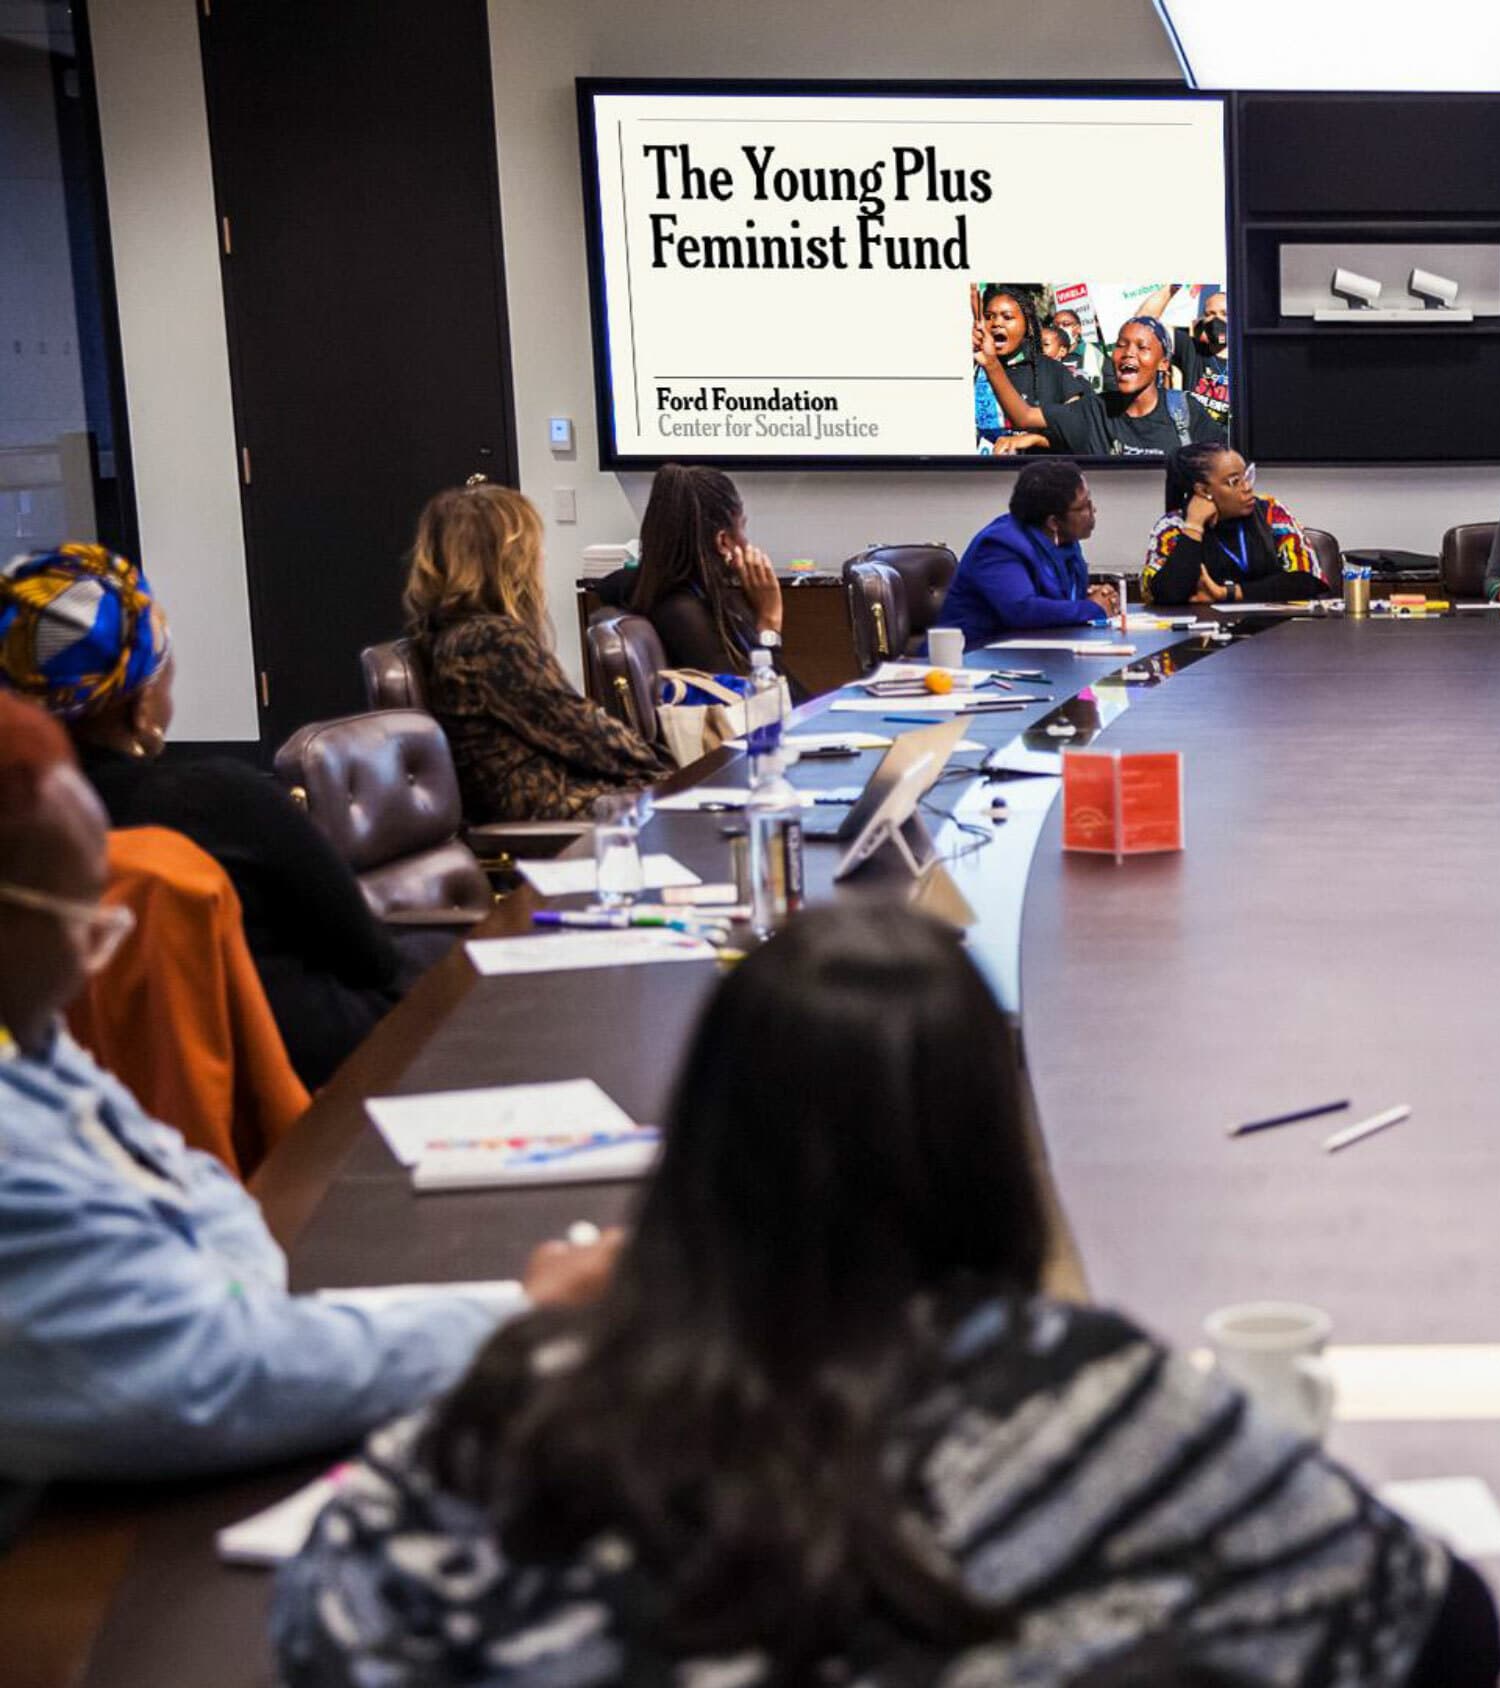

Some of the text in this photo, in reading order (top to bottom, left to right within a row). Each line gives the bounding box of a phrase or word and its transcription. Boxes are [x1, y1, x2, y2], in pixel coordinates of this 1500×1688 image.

[643, 144, 992, 214] The Young Plus
[650, 214, 970, 270] Feminist Fund
[656, 387, 838, 411] Ford Foundation
[657, 414, 879, 440] Center for Social Justice
